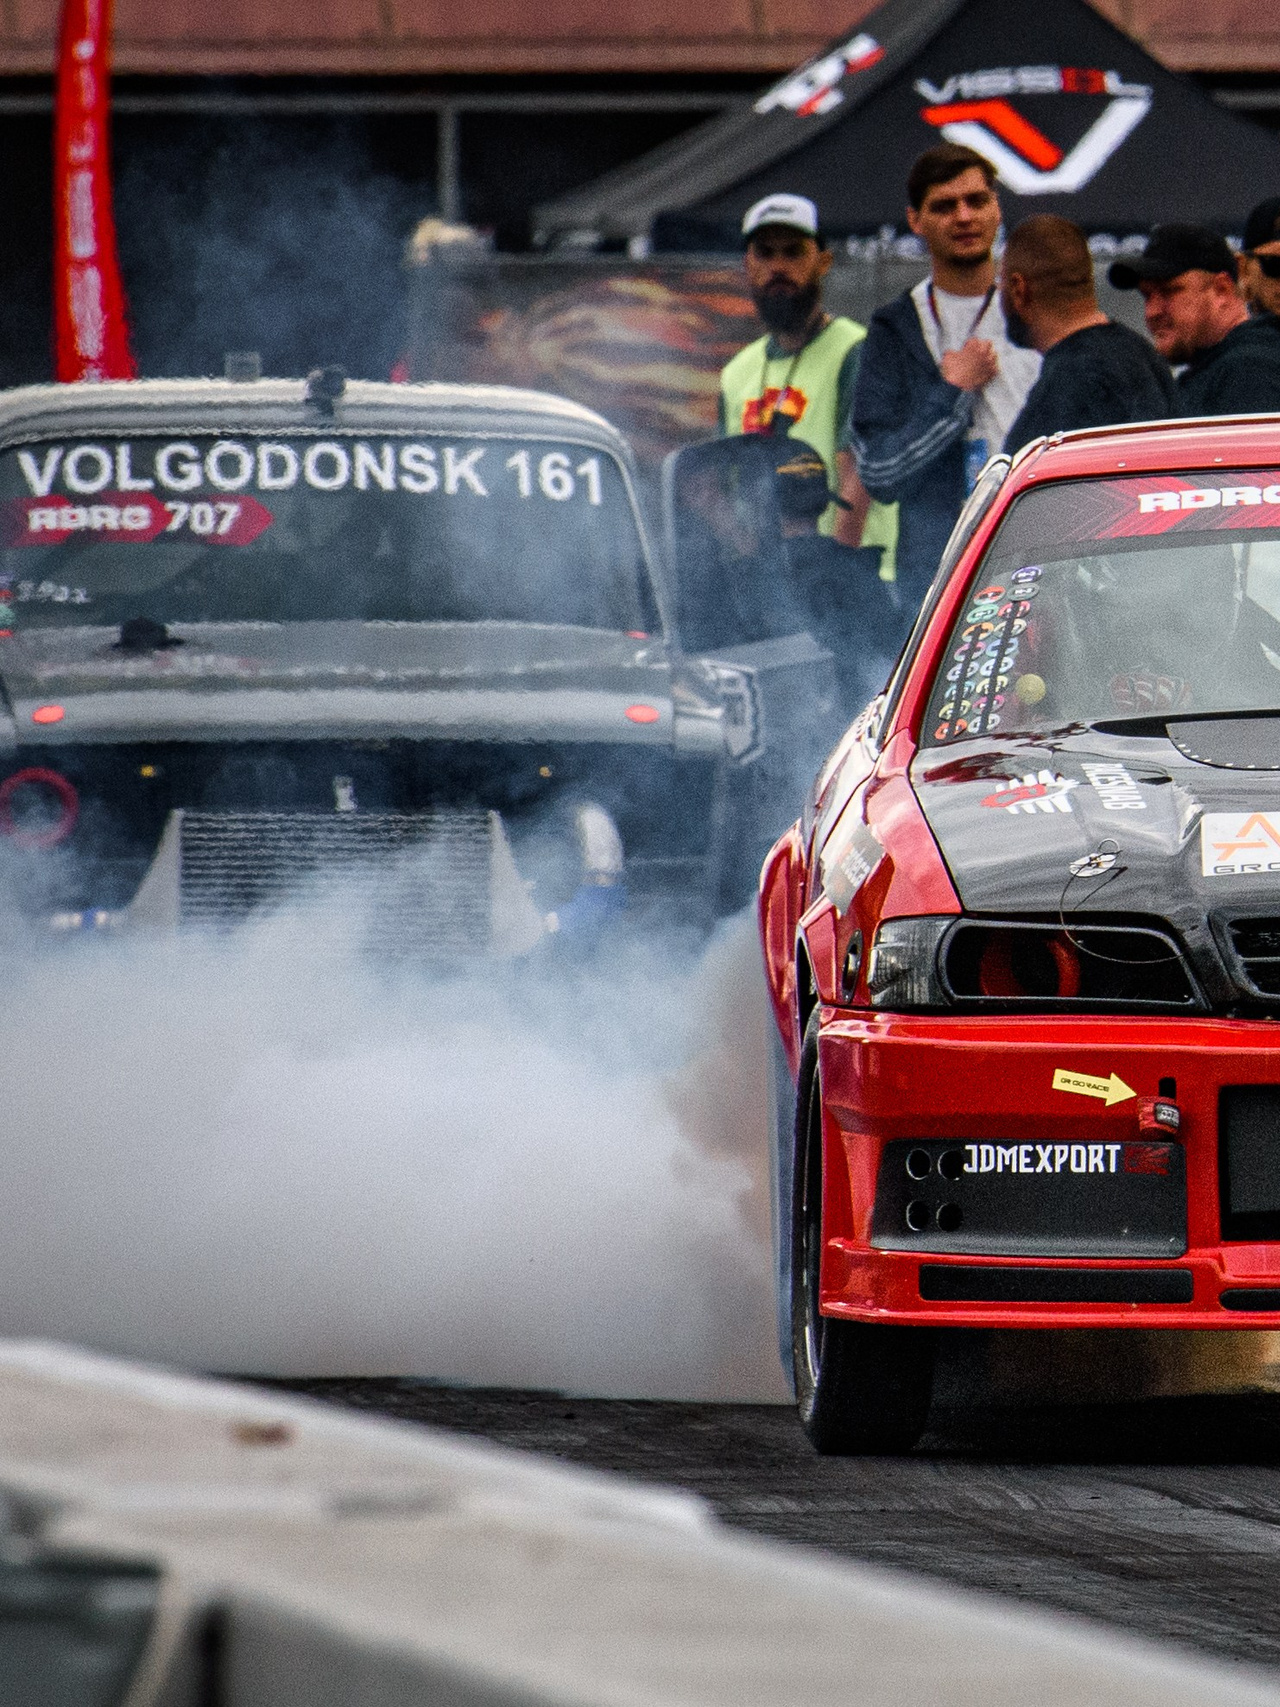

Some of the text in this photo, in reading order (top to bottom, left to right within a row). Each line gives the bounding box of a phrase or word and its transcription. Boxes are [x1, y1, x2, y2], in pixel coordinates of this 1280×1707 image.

[17, 440, 602, 505] VOLGODONSK 161
[163, 501, 241, 535] 707
[963, 1145, 1121, 1173] JDMEXPORT
